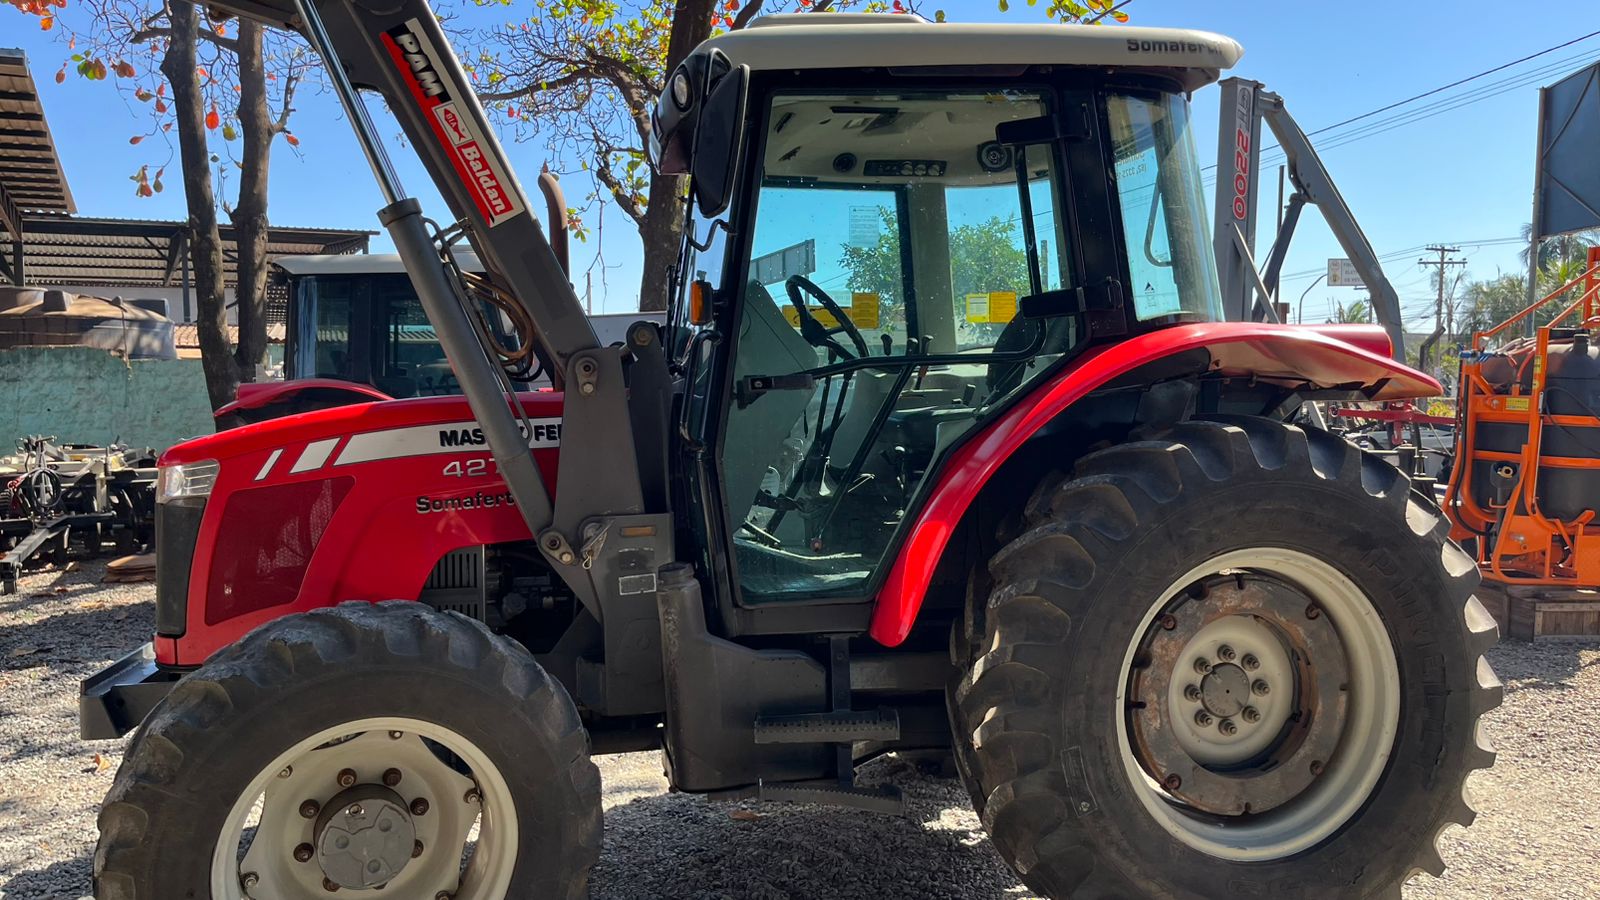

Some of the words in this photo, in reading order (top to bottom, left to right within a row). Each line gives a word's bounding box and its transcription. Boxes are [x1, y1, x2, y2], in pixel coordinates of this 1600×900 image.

[395, 33, 445, 97] PAM
[461, 145, 506, 213] Baldan
[1233, 128, 1249, 220] 2200
[416, 491, 515, 514] Somafert
